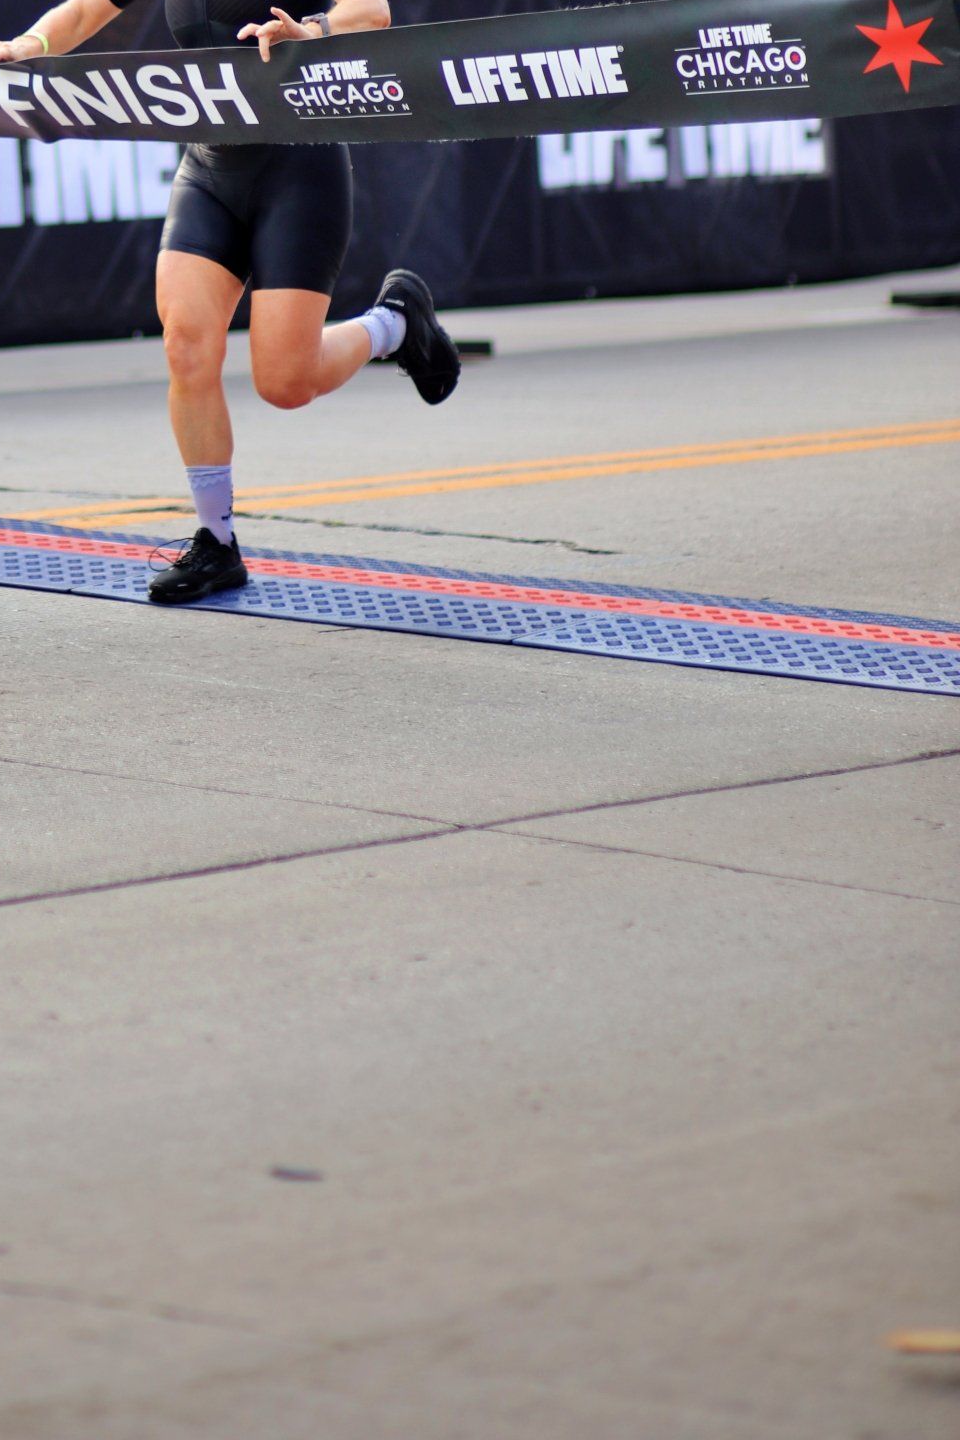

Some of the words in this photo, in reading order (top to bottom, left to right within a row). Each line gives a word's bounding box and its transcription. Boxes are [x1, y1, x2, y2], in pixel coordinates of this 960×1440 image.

[676, 46, 807, 78] CHICAGO
[683, 73, 809, 90] TRIATHLON
[283, 80, 404, 107] CHICAGO
[294, 103, 410, 116] TRIATHLON
